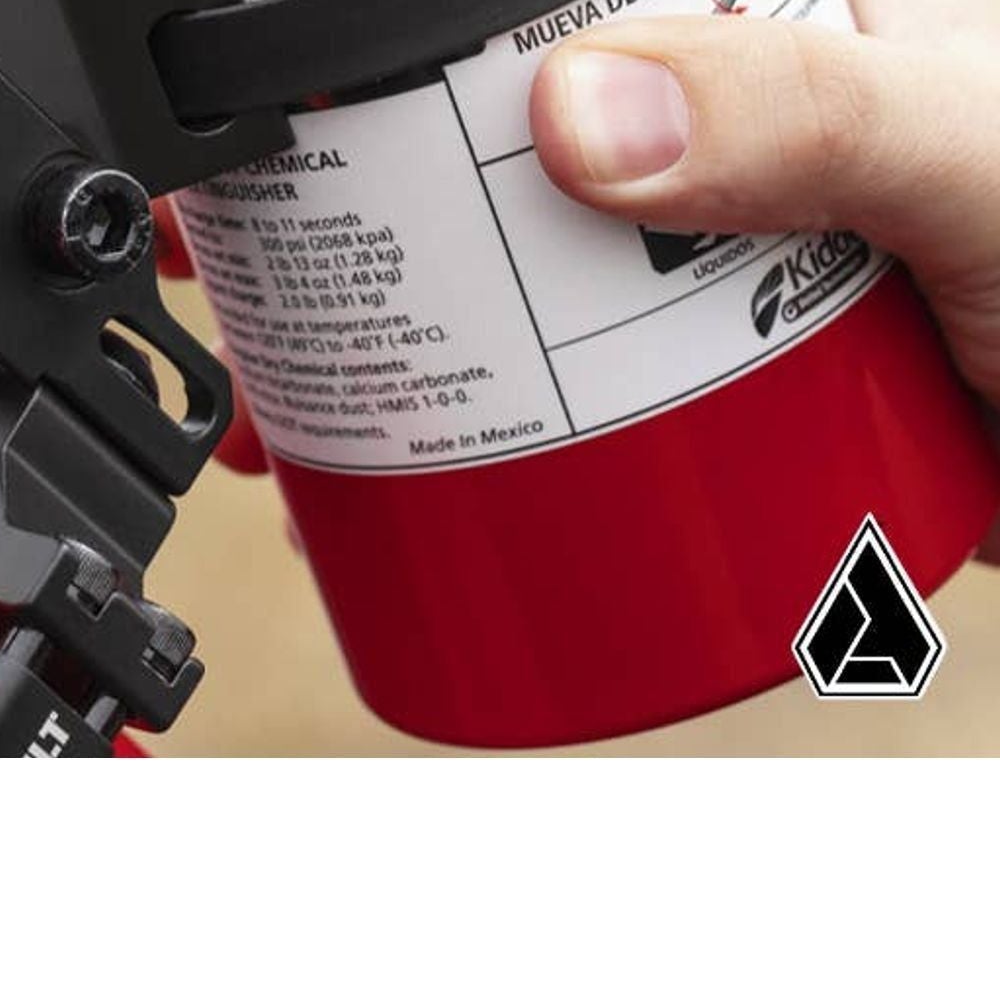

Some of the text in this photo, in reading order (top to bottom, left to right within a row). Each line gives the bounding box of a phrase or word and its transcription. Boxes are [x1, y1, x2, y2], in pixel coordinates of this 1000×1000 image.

[512, 0, 605, 56] MUEVA
[247, 149, 349, 176] CHEMICAL
[281, 217, 296, 232] 11
[298, 211, 363, 233] seconds
[310, 234, 354, 252] (2068
[357, 226, 395, 249] kpa)
[333, 252, 374, 271] (1.28
[377, 246, 405, 266] kg)
[333, 270, 373, 290] (1.48
[375, 266, 403, 286] kg)
[358, 289, 387, 309] kg)
[306, 313, 413, 335] temperatures
[340, 359, 414, 377] contents:
[342, 381, 399, 396] calcium
[401, 364, 495, 394] carbonate,
[408, 418, 545, 456] Made In Mexico
